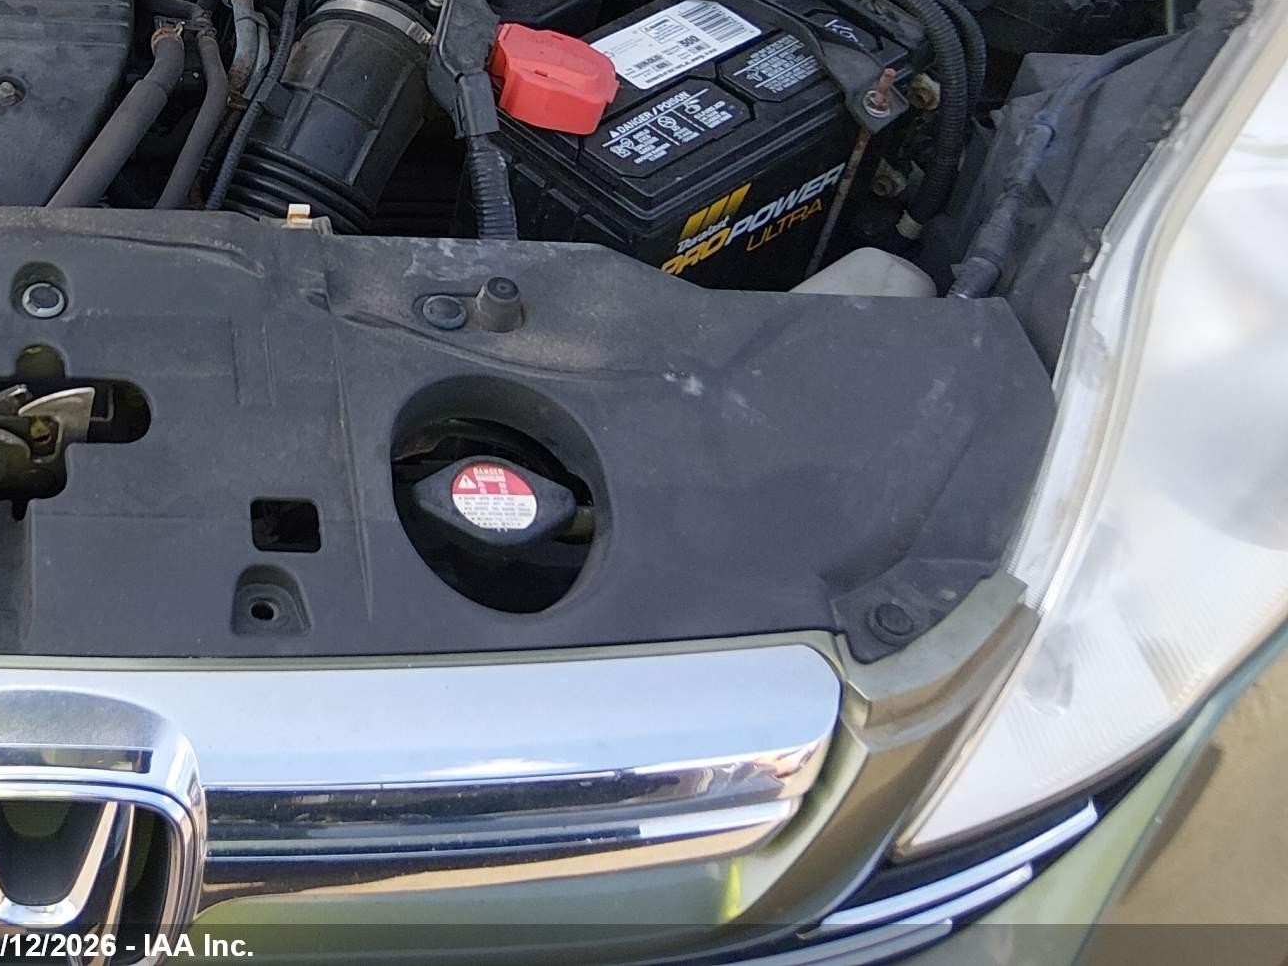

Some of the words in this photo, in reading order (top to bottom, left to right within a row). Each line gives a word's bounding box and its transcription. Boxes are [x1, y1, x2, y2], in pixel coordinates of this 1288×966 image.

[616, 112, 654, 134] DANGER
[658, 91, 691, 111] POISON
[746, 198, 824, 252] ULTRA
